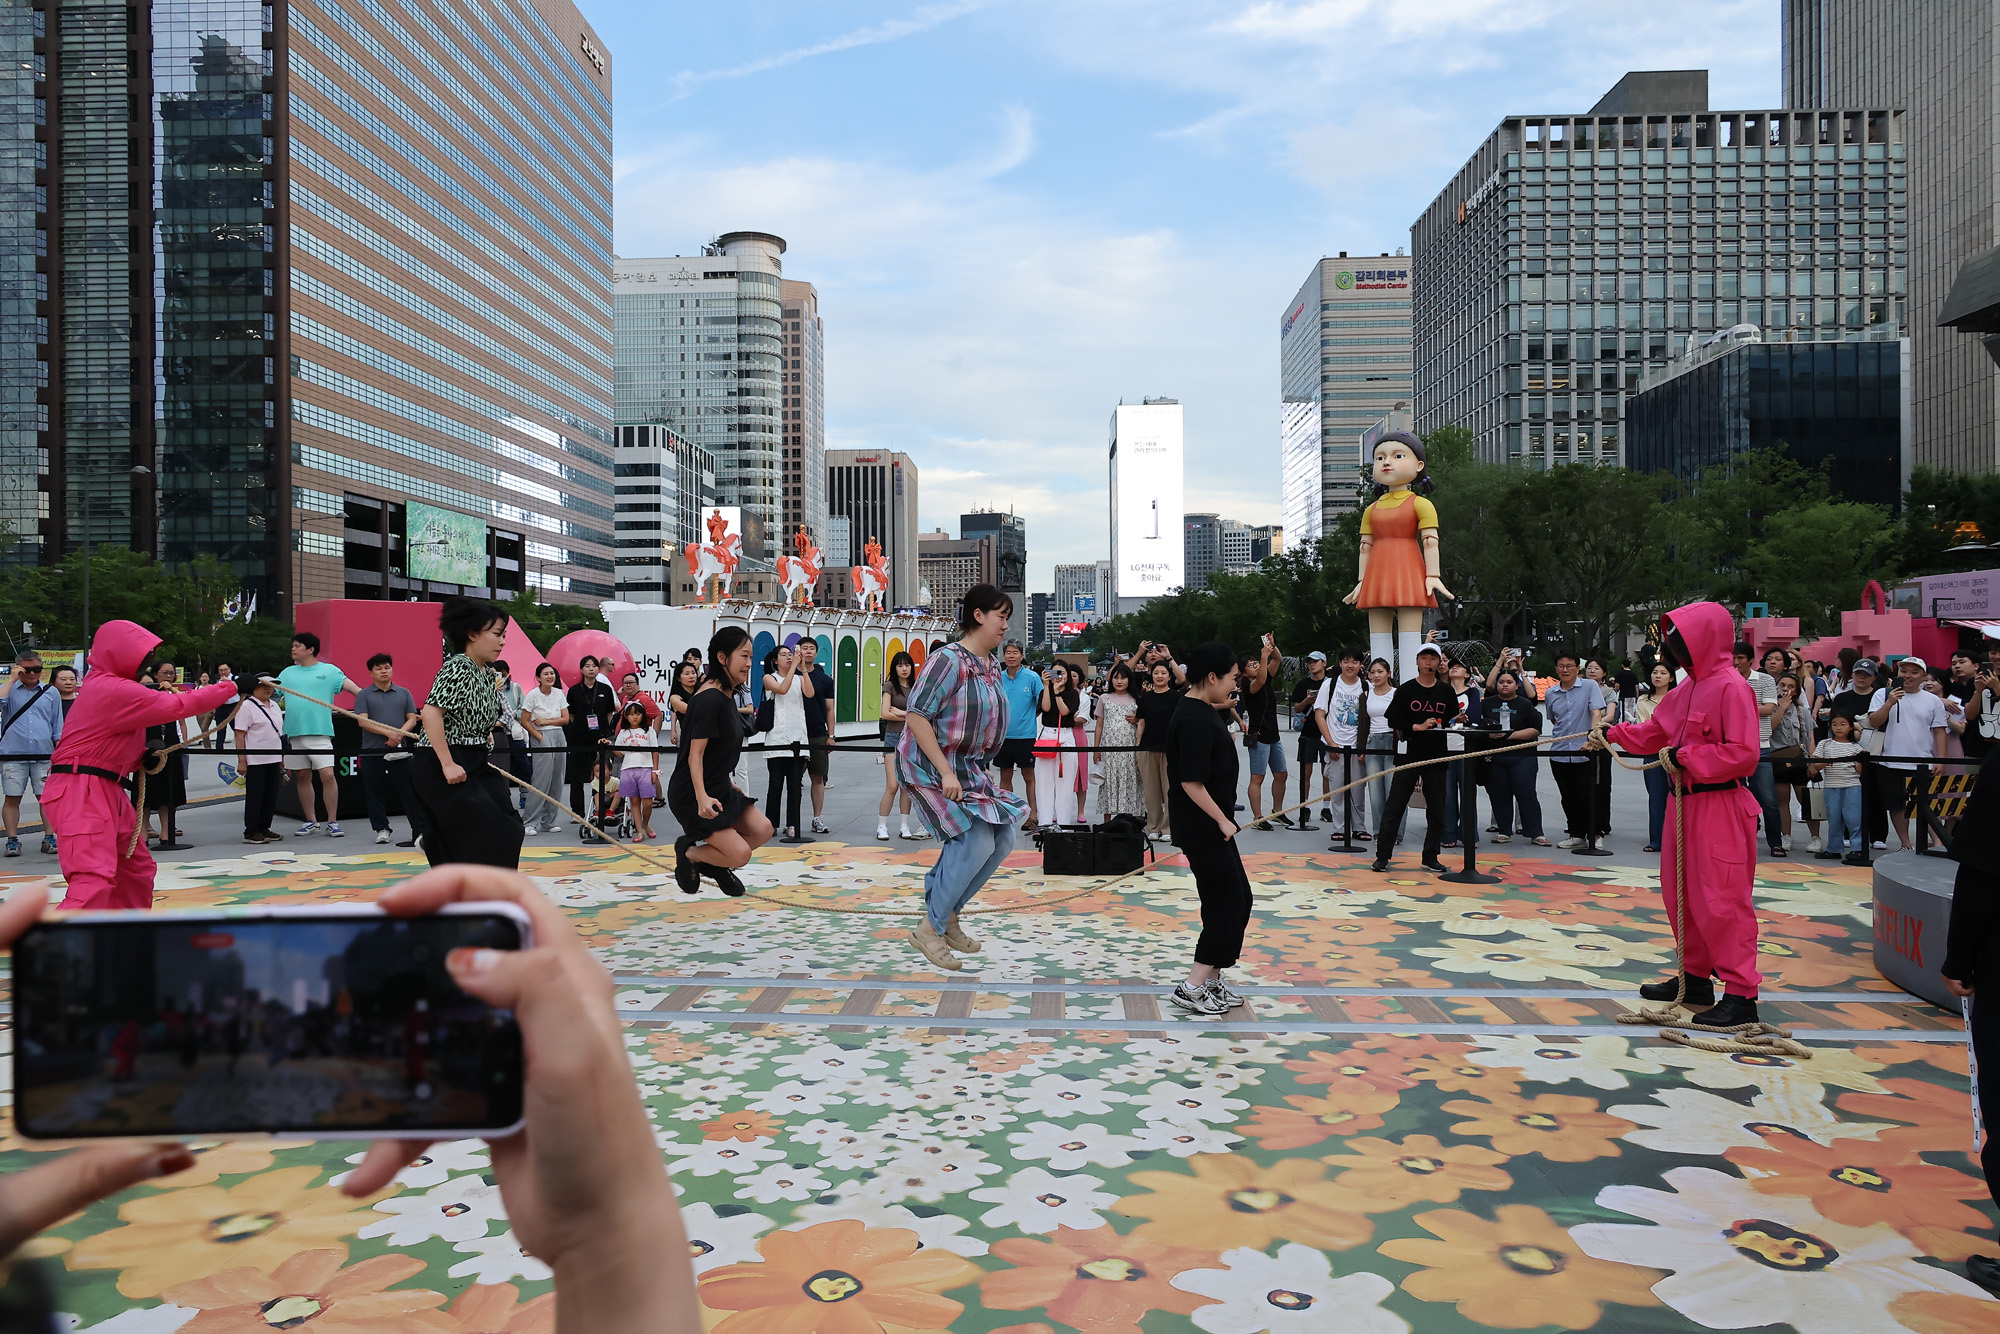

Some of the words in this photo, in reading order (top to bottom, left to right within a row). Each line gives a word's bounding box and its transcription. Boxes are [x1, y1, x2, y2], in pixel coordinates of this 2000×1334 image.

[667, 272, 700, 280] CHANNEL
[1355, 269, 1408, 282] 감리회본부
[1130, 563, 1155, 571] LG전자
[1960, 580, 1970, 588] 아트
[1953, 602, 1962, 611] to
[1962, 599, 1989, 610] warhol
